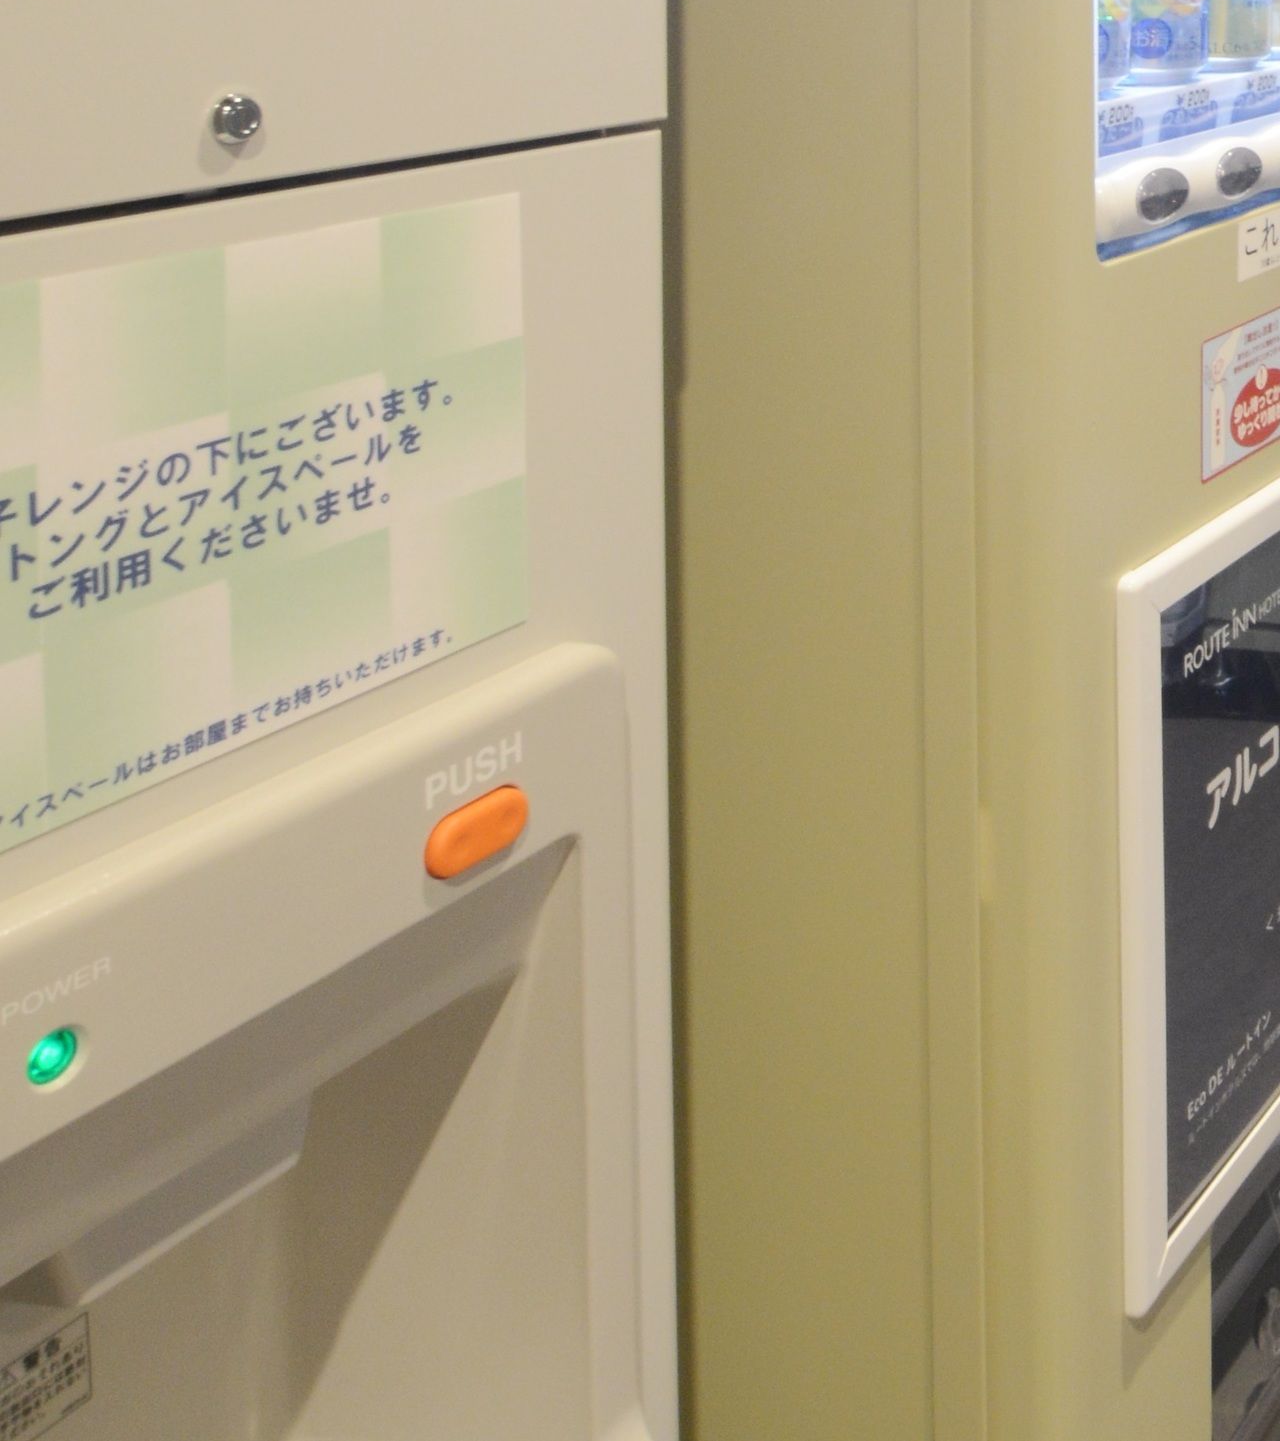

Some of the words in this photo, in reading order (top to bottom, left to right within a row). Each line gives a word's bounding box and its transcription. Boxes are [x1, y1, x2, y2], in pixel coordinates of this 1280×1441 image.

[11, 424, 422, 581] トングとアイスペールを
[29, 478, 391, 620] ご利用くださいませ。
[1183, 626, 1231, 678] ROUTE
[0, 628, 453, 828] イスペールはお部屋までお持ちいただけます。
[424, 731, 523, 810] PUSH
[1, 956, 112, 1026] POWER
[1186, 1089, 1207, 1121] Eco
[1208, 1072, 1225, 1093] DE
